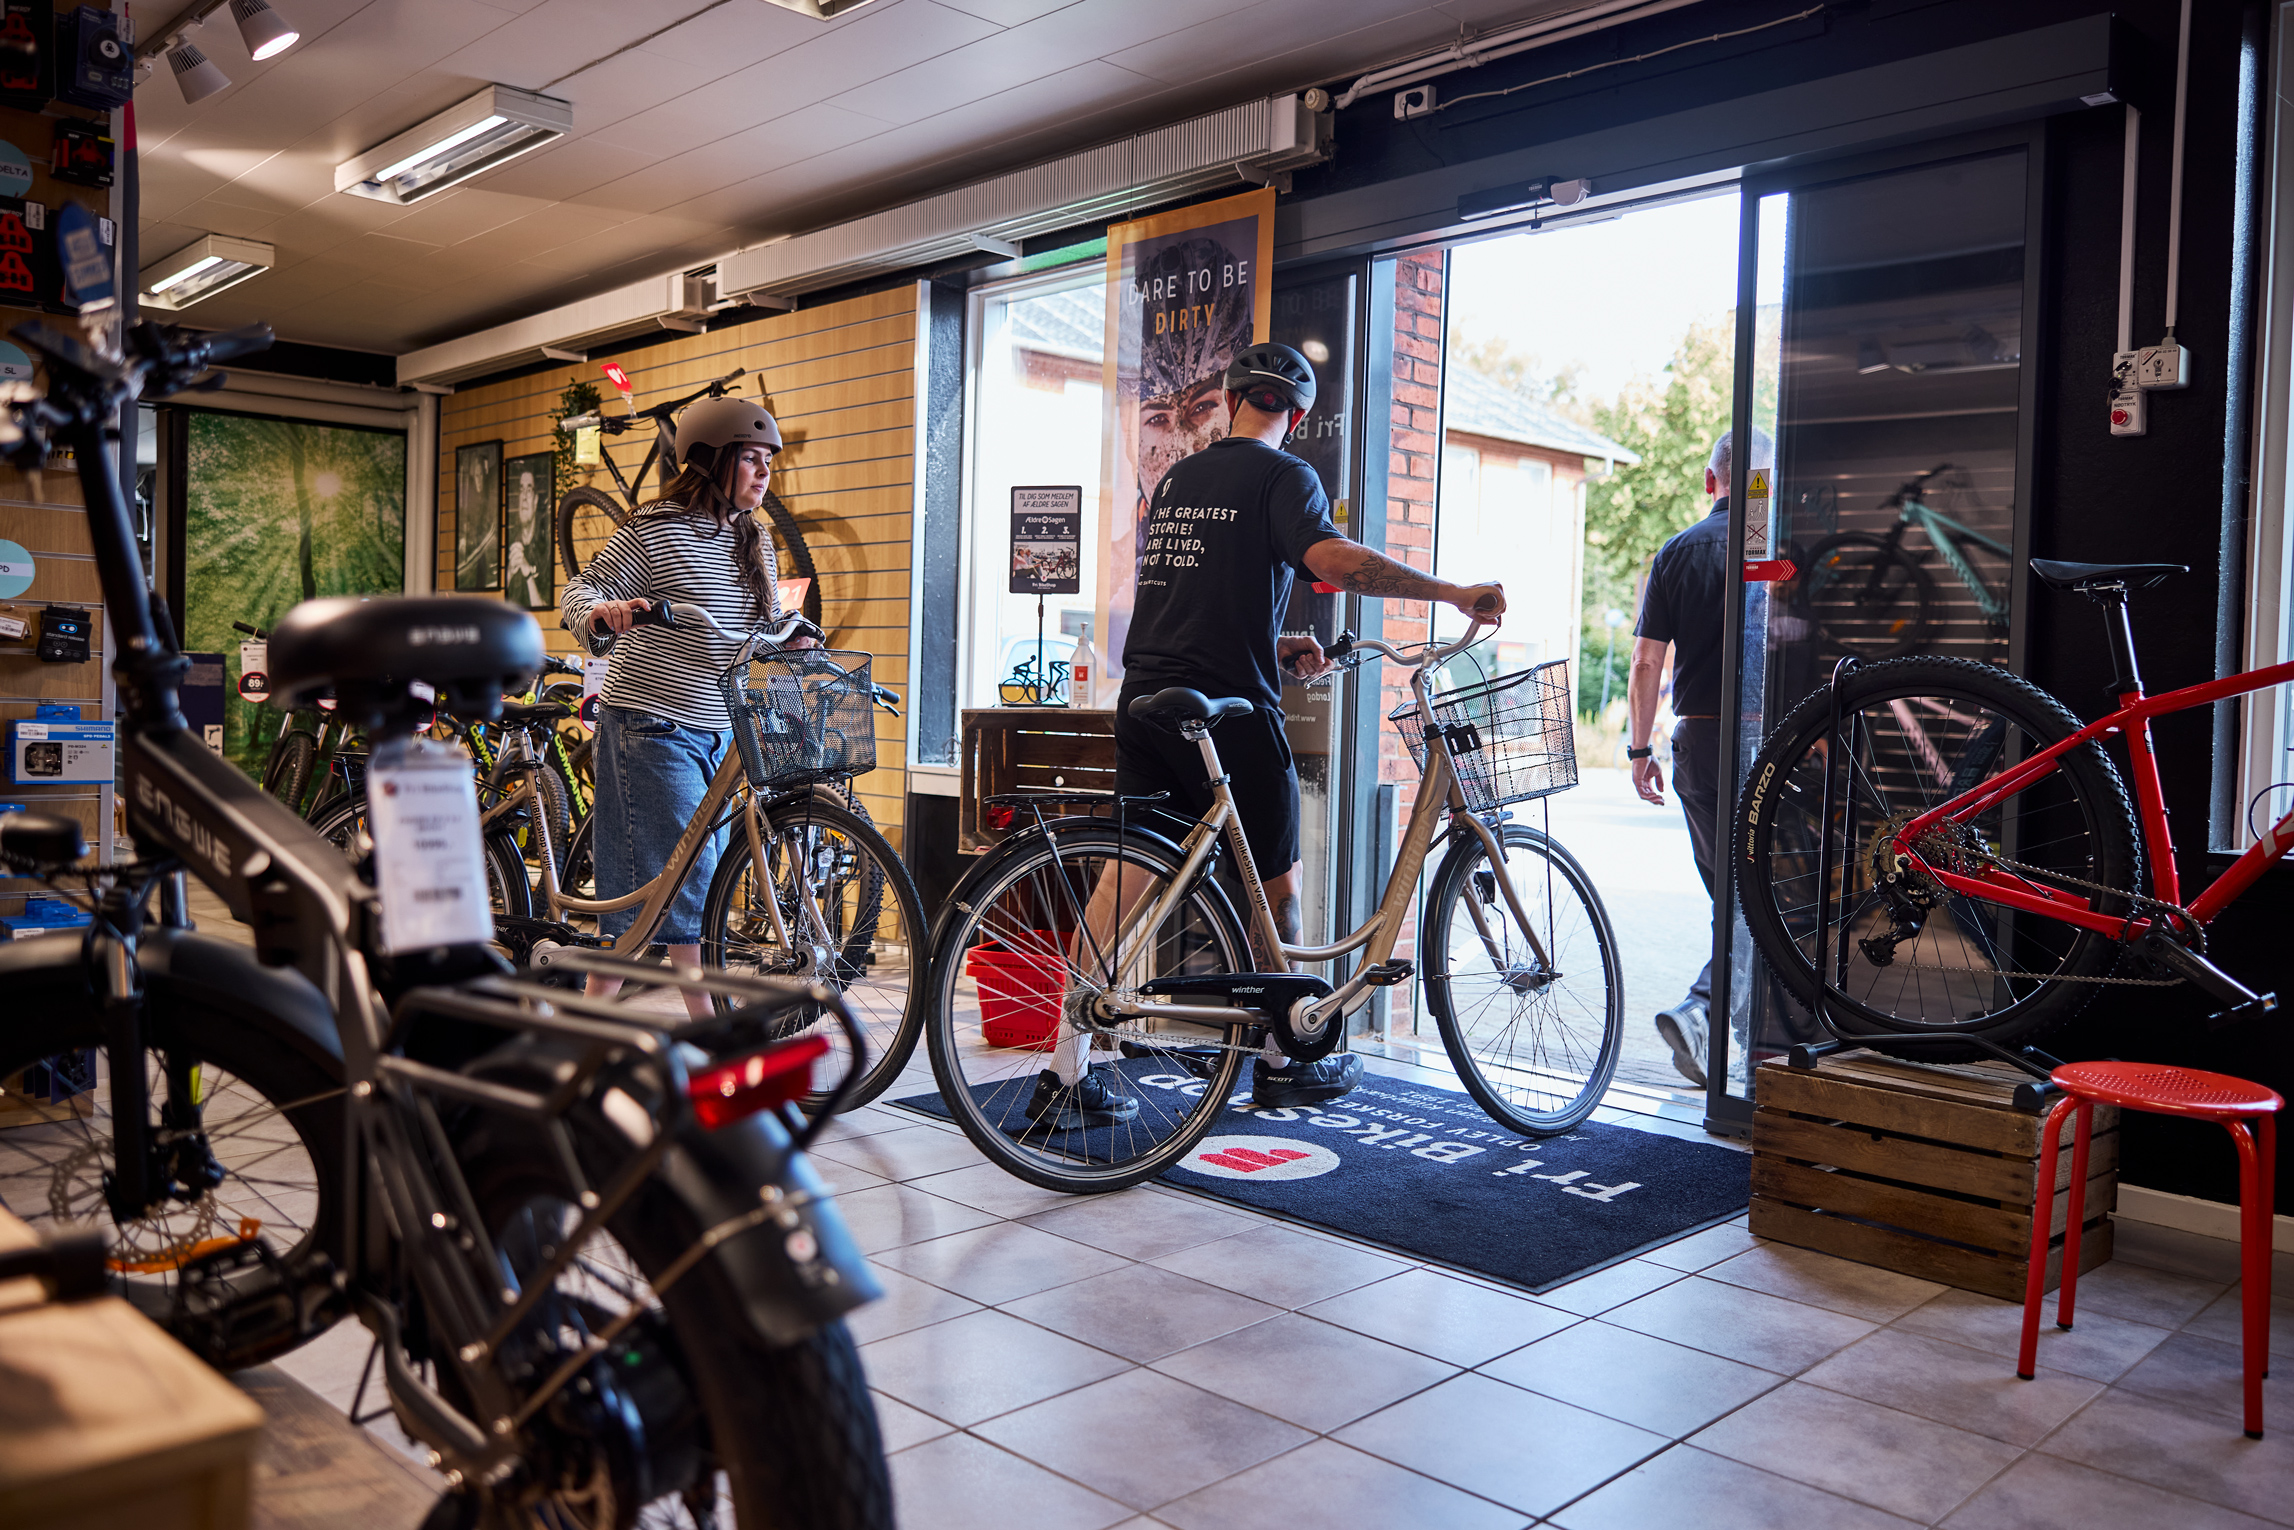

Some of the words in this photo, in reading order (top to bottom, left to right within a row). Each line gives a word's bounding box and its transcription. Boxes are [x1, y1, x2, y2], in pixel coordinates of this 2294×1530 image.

[1128, 275, 1177, 306] DARE
[1188, 268, 1211, 294] TO
[1223, 260, 1248, 288] BE
[1155, 303, 1215, 335] DIRTY
[4, 366, 17, 375] SL
[1049, 516, 1065, 524] Sagen
[1174, 507, 1238, 522] GREATEST
[1021, 526, 1026, 534] 1.
[1041, 526, 1048, 534] 2.
[1063, 526, 1070, 534] 3.
[1149, 522, 1193, 535] STORIES
[1146, 538, 1163, 551] ARE
[1166, 538, 1205, 554] LIVED,
[1142, 553, 1161, 567] NOT
[1165, 554, 1199, 567] TOLD.
[553, 733, 588, 819] COMPANIO
[1748, 762, 1776, 825] BARZO
[530, 796, 547, 848] FriBikeShop
[542, 848, 552, 872] Vejle
[666, 786, 714, 871] winther
[1747, 827, 1756, 856] vittoria
[1231, 826, 1258, 887] FriBikeShop
[1254, 887, 1268, 912] Vejle
[1392, 813, 1431, 908] winther
[493, 925, 509, 933] ther
[1231, 985, 1265, 995] winther
[1266, 1075, 1295, 1084] SCOTT
[1181, 1111, 1199, 1130] winther
[1325, 1097, 1445, 1129] FORSKEL
[1445, 1127, 1542, 1151] OPLEV
[1492, 1159, 1643, 1203] Fri
